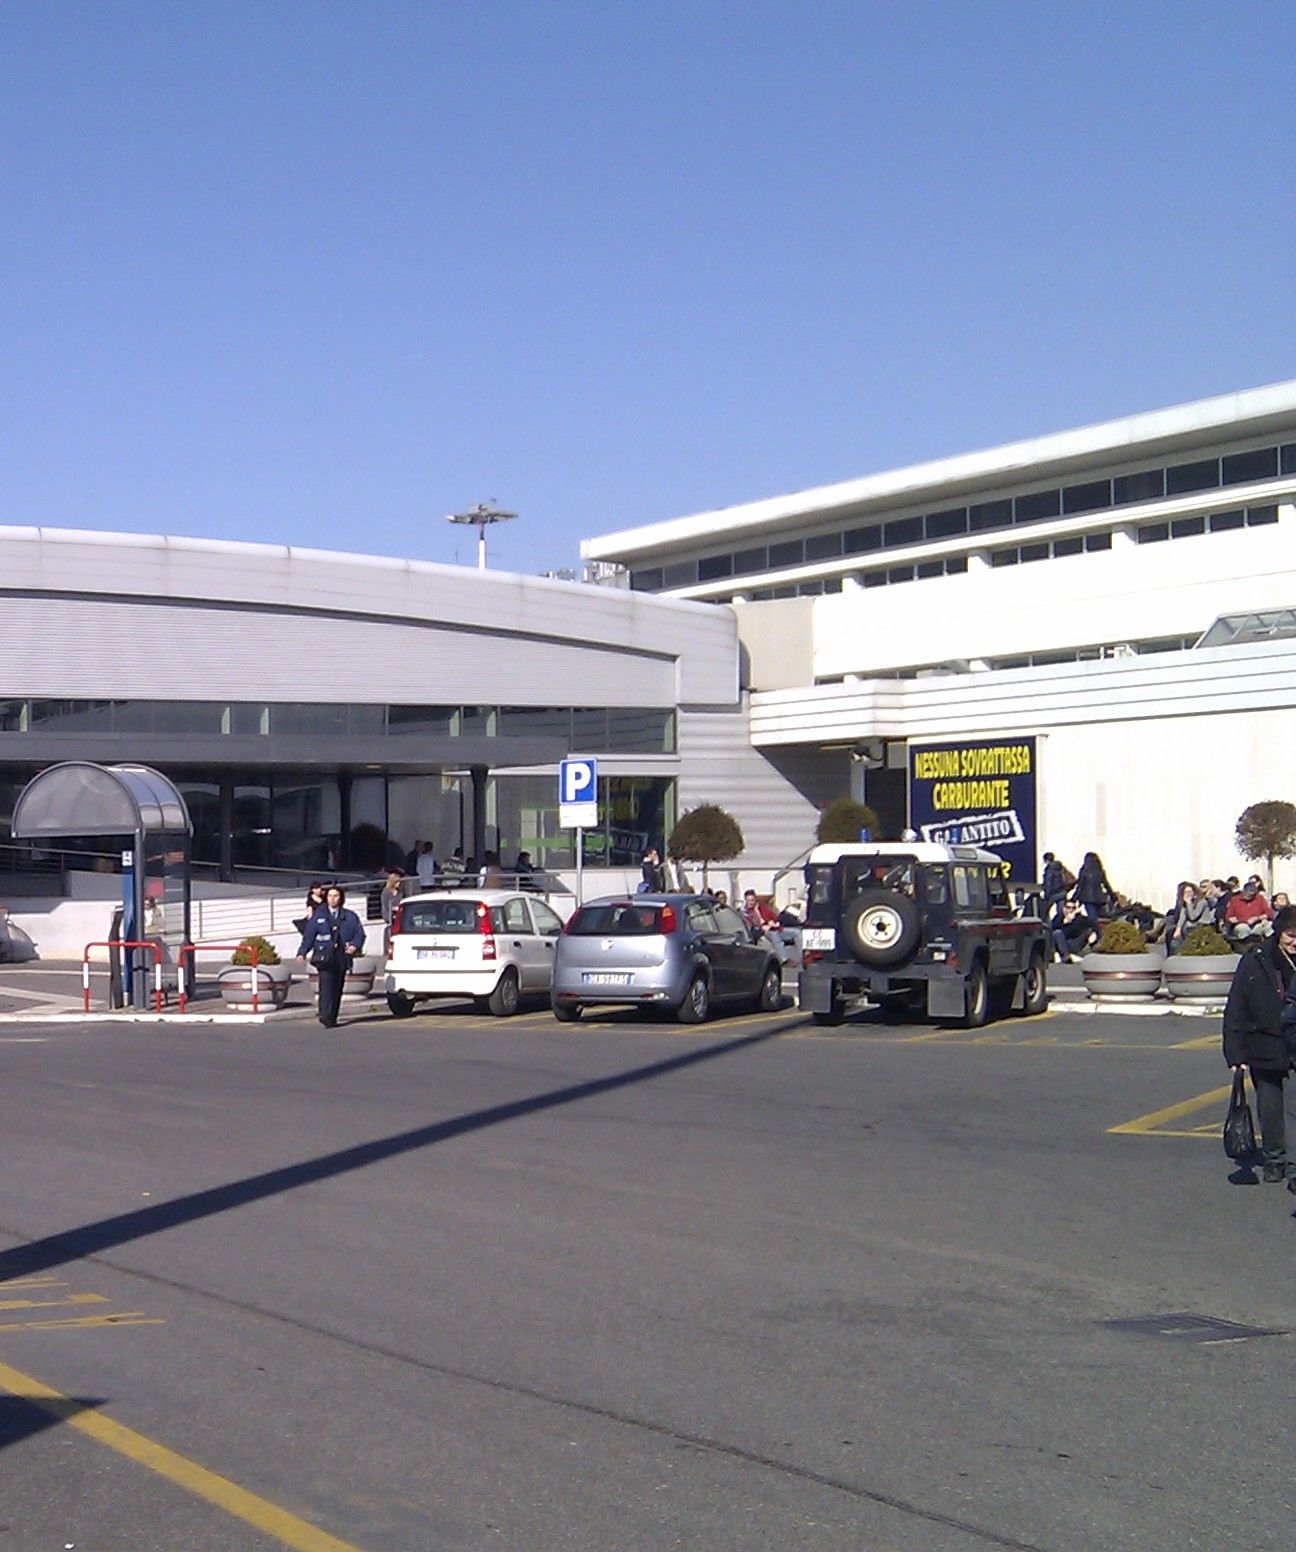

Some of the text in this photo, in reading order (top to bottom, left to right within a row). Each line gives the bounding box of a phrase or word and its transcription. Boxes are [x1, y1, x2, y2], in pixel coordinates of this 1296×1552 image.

[915, 745, 1031, 779] NESSUNA SOVRATTASSA
[566, 763, 591, 801] P
[933, 780, 1009, 810] CARBURANTE
[934, 820, 1010, 845] GAANTITO
